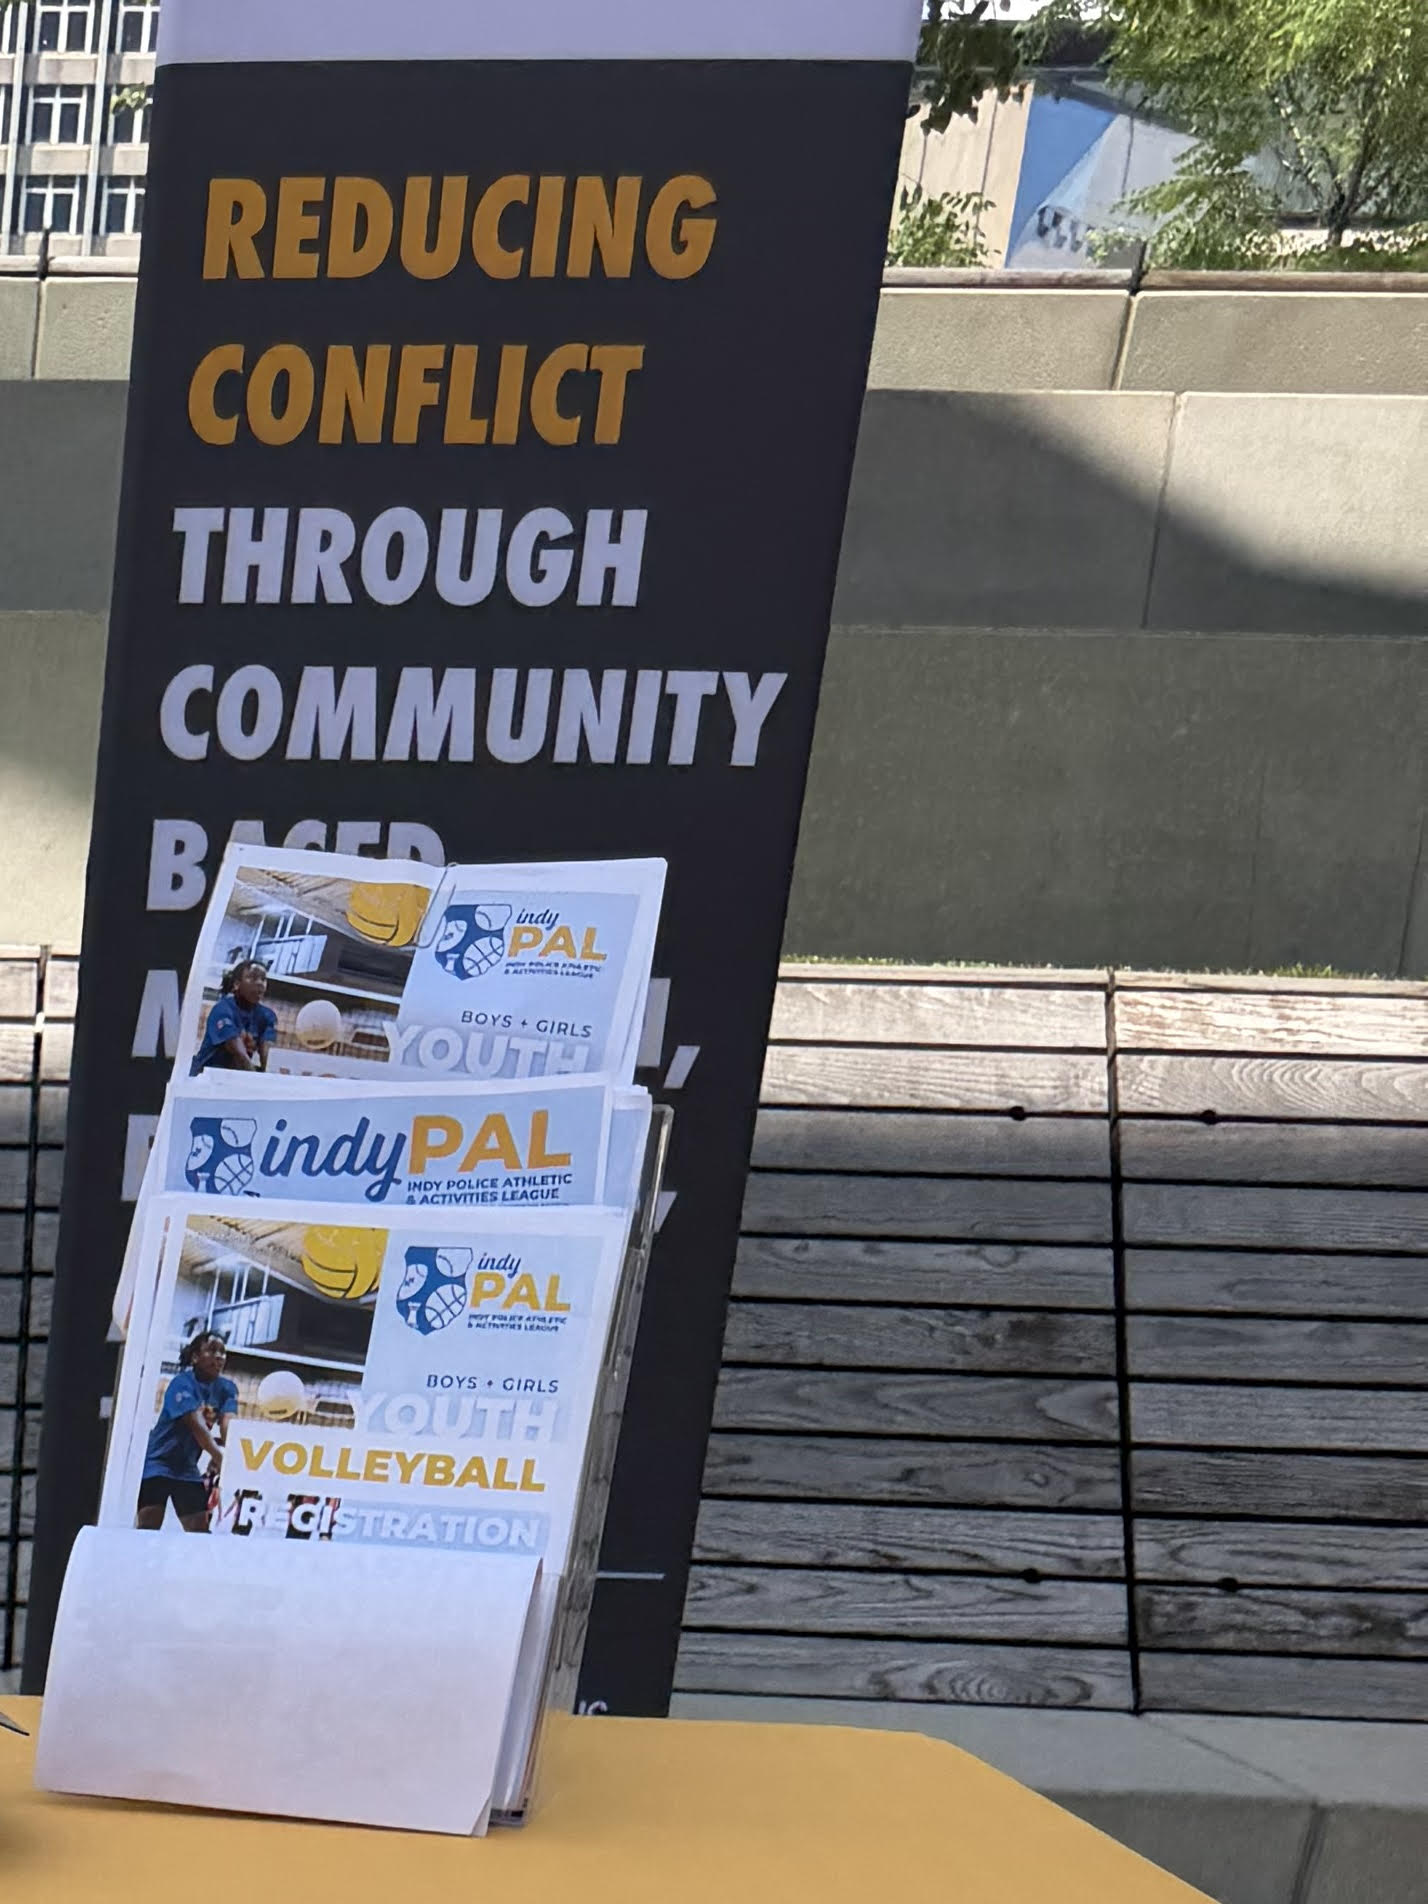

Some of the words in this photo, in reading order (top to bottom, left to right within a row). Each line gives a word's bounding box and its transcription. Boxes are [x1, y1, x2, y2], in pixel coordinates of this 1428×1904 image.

[203, 175, 717, 280] REDUCING
[188, 343, 643, 446] CONFLICT
[172, 506, 648, 607] THROUGH
[160, 664, 789, 767] COMMUNITY
[516, 908, 560, 931] indy
[507, 926, 607, 960] PAL
[461, 1011, 512, 1028] BOYS
[536, 1019, 593, 1038] GIRLS
[381, 1021, 591, 1078] YOUTH
[407, 1180, 443, 1193] INDY
[446, 1178, 499, 1190] POLICE
[502, 1174, 573, 1188] ATHLETIC
[419, 1191, 498, 1205] ACTIVITIES
[502, 1187, 560, 1202] LEAGUE
[477, 1252, 522, 1279] indy
[470, 1272, 571, 1312] PAL
[426, 1374, 478, 1390] BOYS
[502, 1377, 559, 1393] GIRLS
[349, 1389, 559, 1443] YOUTH
[240, 1438, 546, 1493] VOLLEYBALL
[239, 1501, 540, 1548] REGISTRATION
